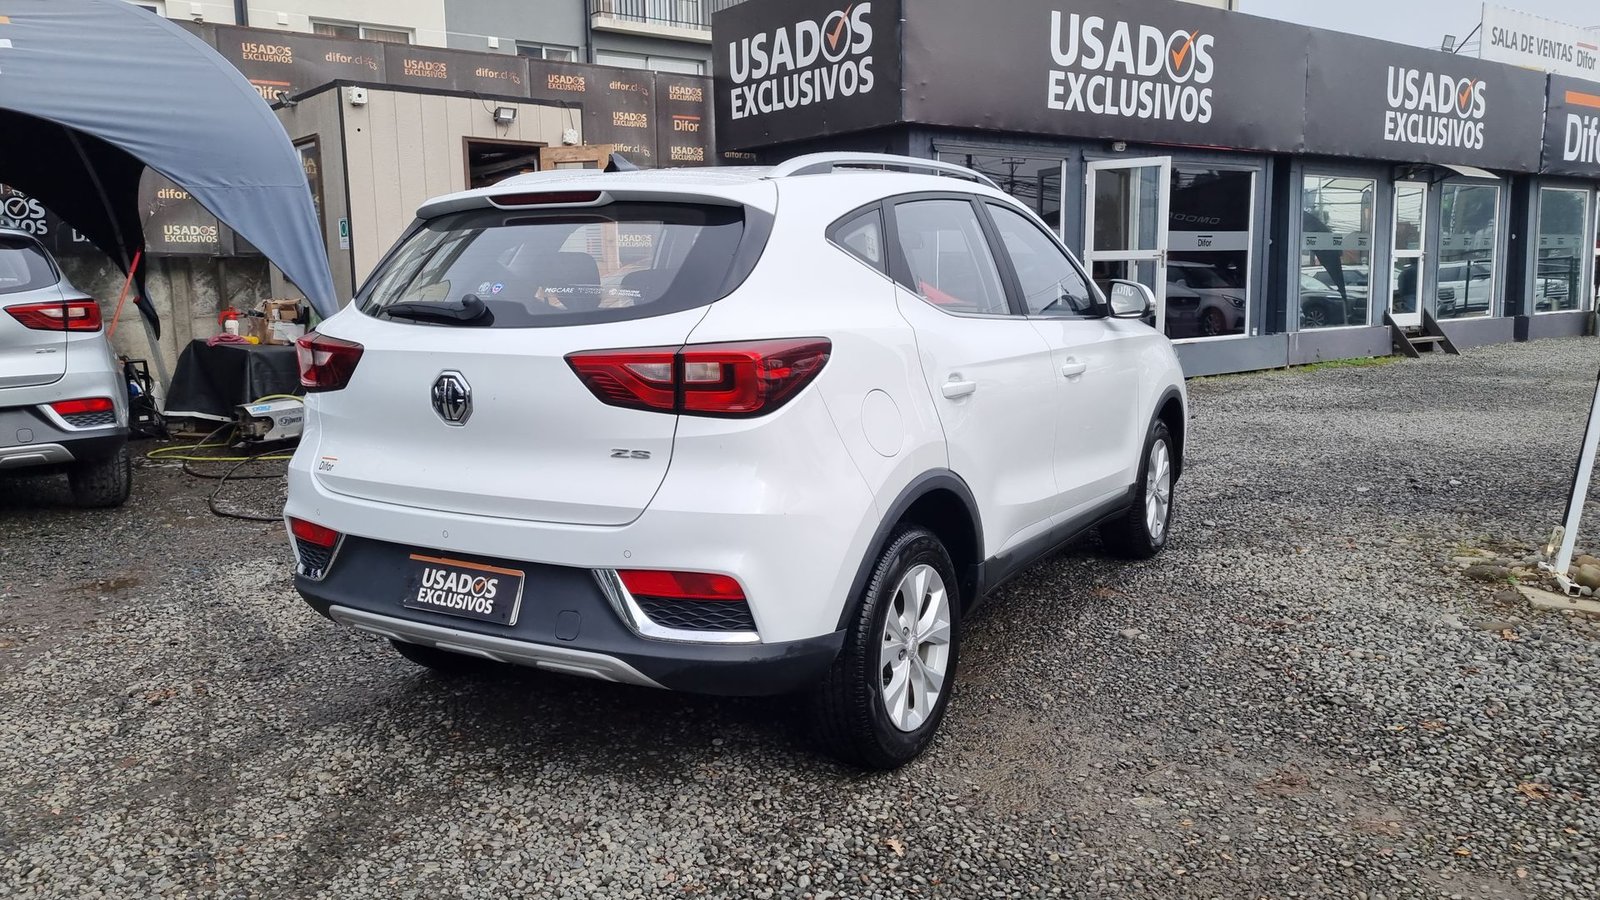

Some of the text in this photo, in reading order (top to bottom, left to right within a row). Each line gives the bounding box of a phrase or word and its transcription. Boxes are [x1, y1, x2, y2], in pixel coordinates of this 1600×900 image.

[729, 2, 873, 84] USADOS
[1050, 10, 1215, 84] USADOS
[1491, 26, 1597, 71] SALA DE VENTAS Difor
[241, 42, 292, 57] USADOS
[242, 52, 293, 64] EXCLUSIVOS
[325, 51, 363, 65] difor.cl
[403, 59, 447, 73] USADOS
[404, 68, 448, 79] EXCLUSIVOS
[475, 67, 508, 79] difor.cl
[547, 74, 585, 86] USADOS
[609, 80, 638, 91] difor.cl
[547, 82, 586, 92] EXCLUSIVOS
[669, 85, 702, 97] USADOS
[730, 56, 875, 120] EXCLUSIVOS
[1387, 65, 1487, 119] USADOS
[669, 93, 703, 103] EXCLUSIVOS
[1047, 69, 1213, 124] EXCLUSIVOS
[612, 111, 647, 123] USADOS
[613, 119, 648, 129] EXCLUSIVOS
[673, 119, 700, 132] Difor
[1384, 110, 1485, 150] EXCLUSIVOS
[1563, 113, 1600, 163] Dif
[671, 146, 704, 156] USADOS
[671, 153, 704, 162] EXCLUSIVOS
[163, 225, 217, 236] USADOS
[164, 234, 218, 243] EXCLUSIVOS
[1197, 239, 1212, 247] Difor
[610, 448, 651, 460] ZS
[421, 567, 499, 599] USADOS
[416, 587, 494, 615] EXCLUSIVOS
